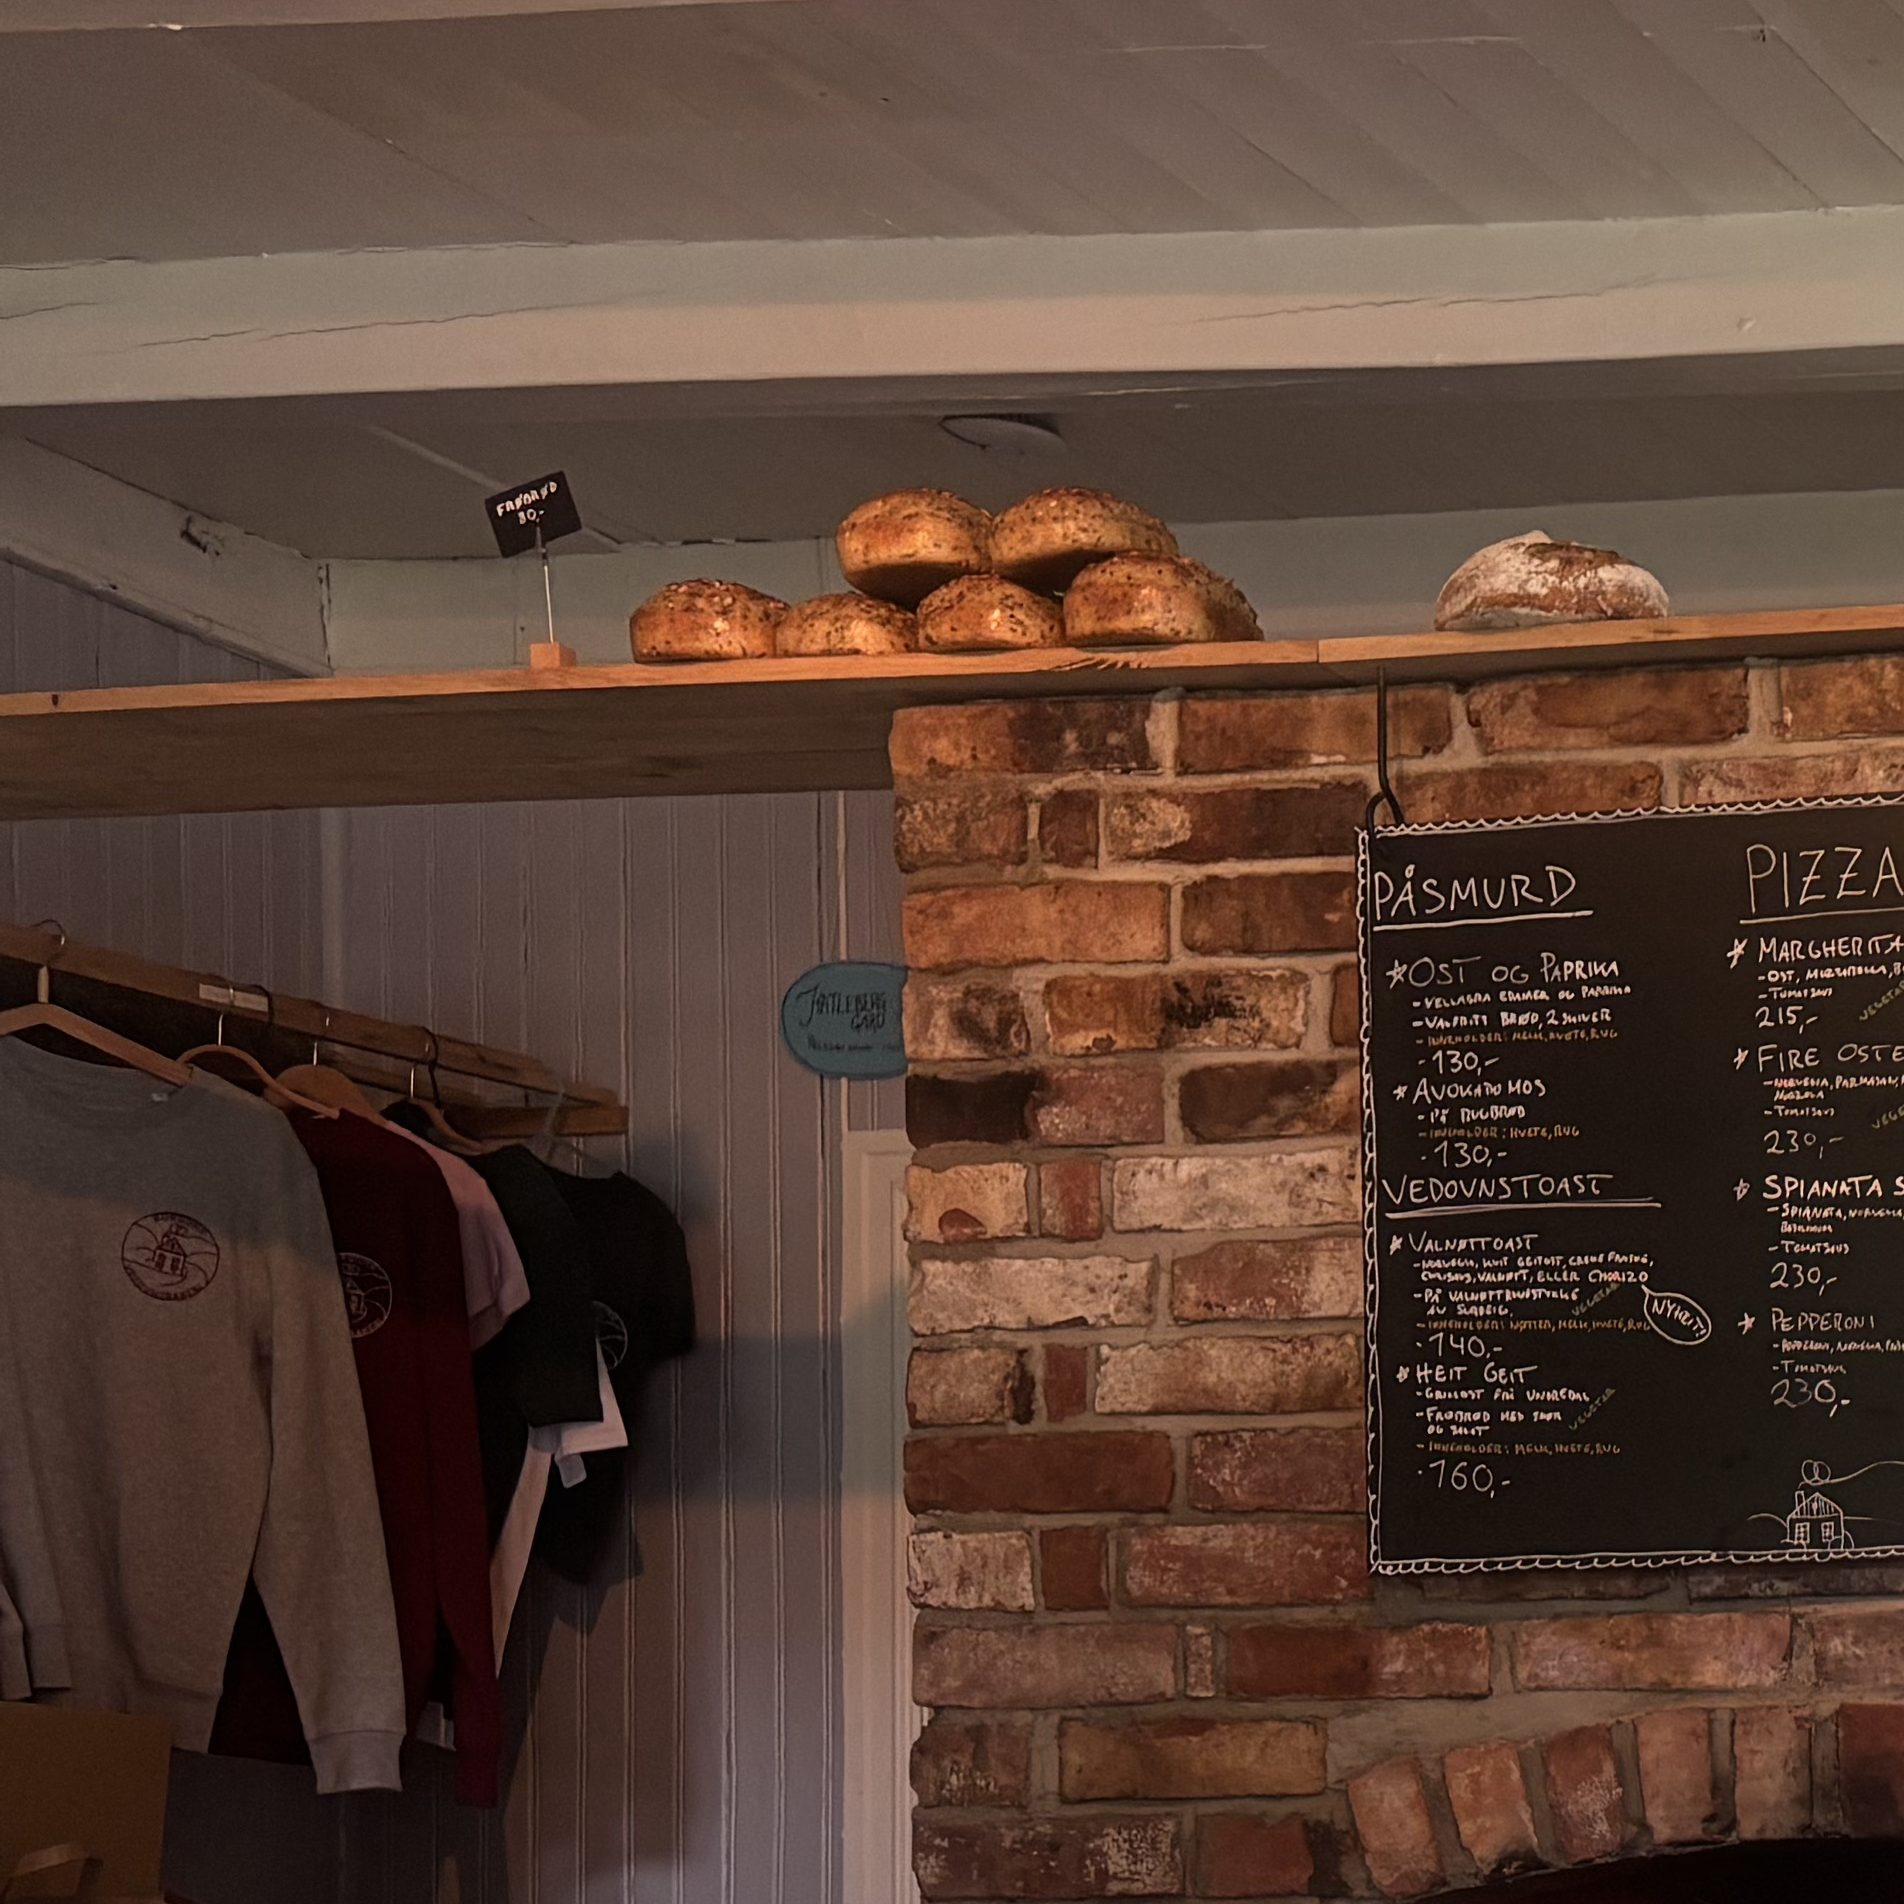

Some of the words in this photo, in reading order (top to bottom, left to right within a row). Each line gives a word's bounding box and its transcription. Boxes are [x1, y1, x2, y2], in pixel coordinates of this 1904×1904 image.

[1373, 864, 1577, 921] PÅSMURD
[1746, 843, 1904, 914] PIZZA
[1758, 934, 1904, 964] MARGHERITA
[1408, 956, 1482, 988] OST
[1491, 965, 1529, 984] OG
[1540, 952, 1619, 984] PAPRIKA
[1546, 1009, 1560, 1026] 2
[1755, 1006, 1819, 1035] 215,-
[1431, 1049, 1500, 1076] 130,-
[1757, 1044, 1821, 1073] FIRE
[1508, 1079, 1546, 1097] MOS
[1434, 1139, 1507, 1168] 130,-
[1763, 1129, 1844, 1159] 230,-
[1381, 1173, 1614, 1204] VEDOVNSTOAST
[1762, 1174, 1883, 1200] SPIANATA
[1408, 1230, 1539, 1252] VALNØTTOAST
[1537, 1270, 1581, 1283] ELLER
[1588, 1269, 1649, 1284] CHORIZO
[1769, 1261, 1838, 1296] 230,-
[1771, 1307, 1875, 1332] PEPPERONI
[1428, 1331, 1503, 1359] 140,-
[1416, 1362, 1468, 1385] HEIT
[1483, 1361, 1538, 1385] GEIT
[1770, 1378, 1851, 1418] 230,-
[1429, 1459, 1511, 1499] 160,-
